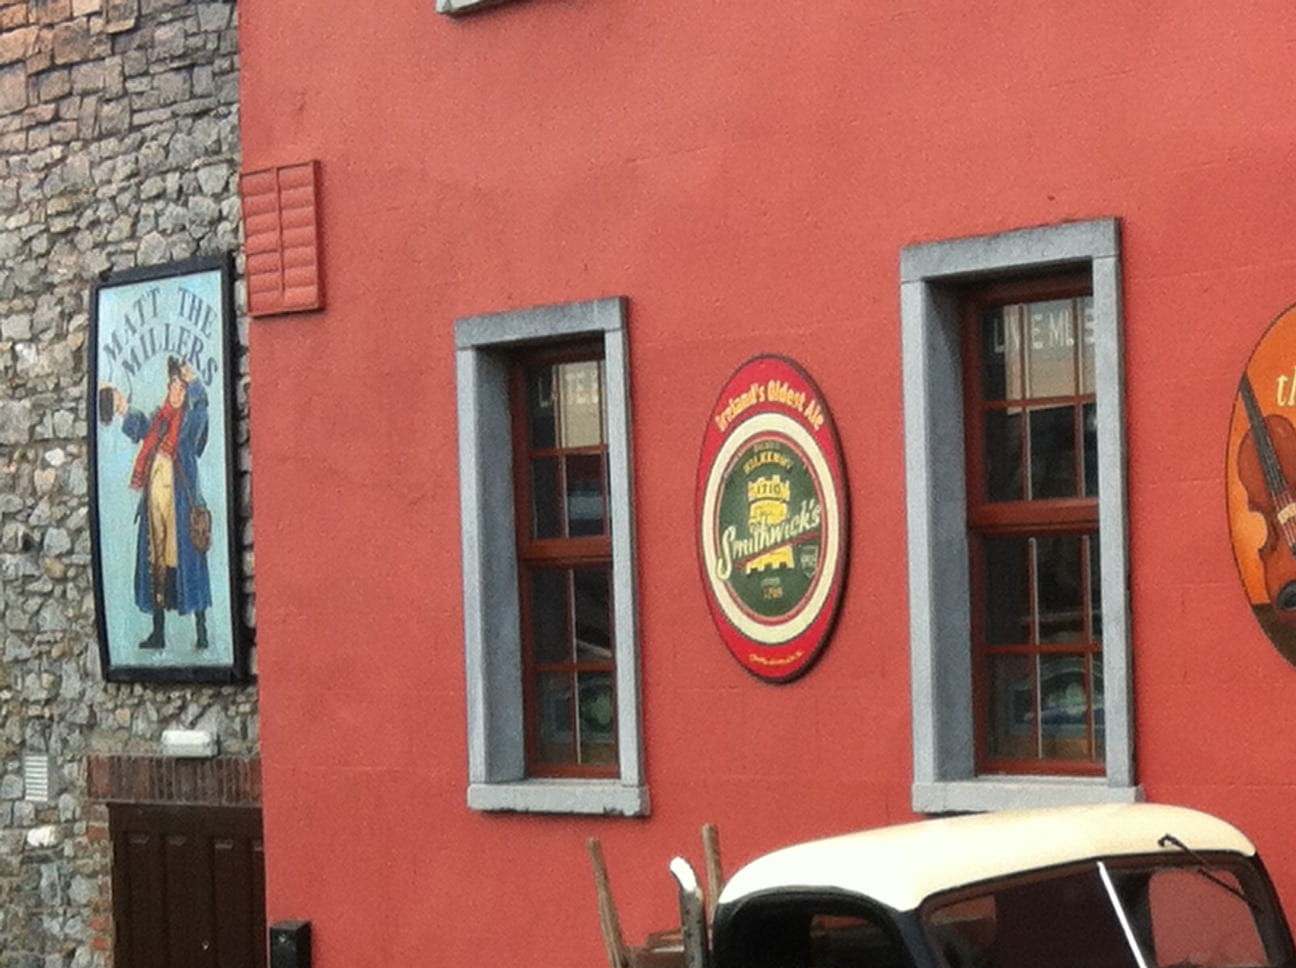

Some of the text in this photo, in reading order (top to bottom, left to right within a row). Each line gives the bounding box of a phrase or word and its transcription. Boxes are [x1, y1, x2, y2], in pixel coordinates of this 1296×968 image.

[103, 286, 218, 382] MATT THE
[121, 322, 218, 404] MILLERS
[714, 379, 824, 432] Ireland's Oldest Ale
[717, 498, 822, 581] Smithwick's
